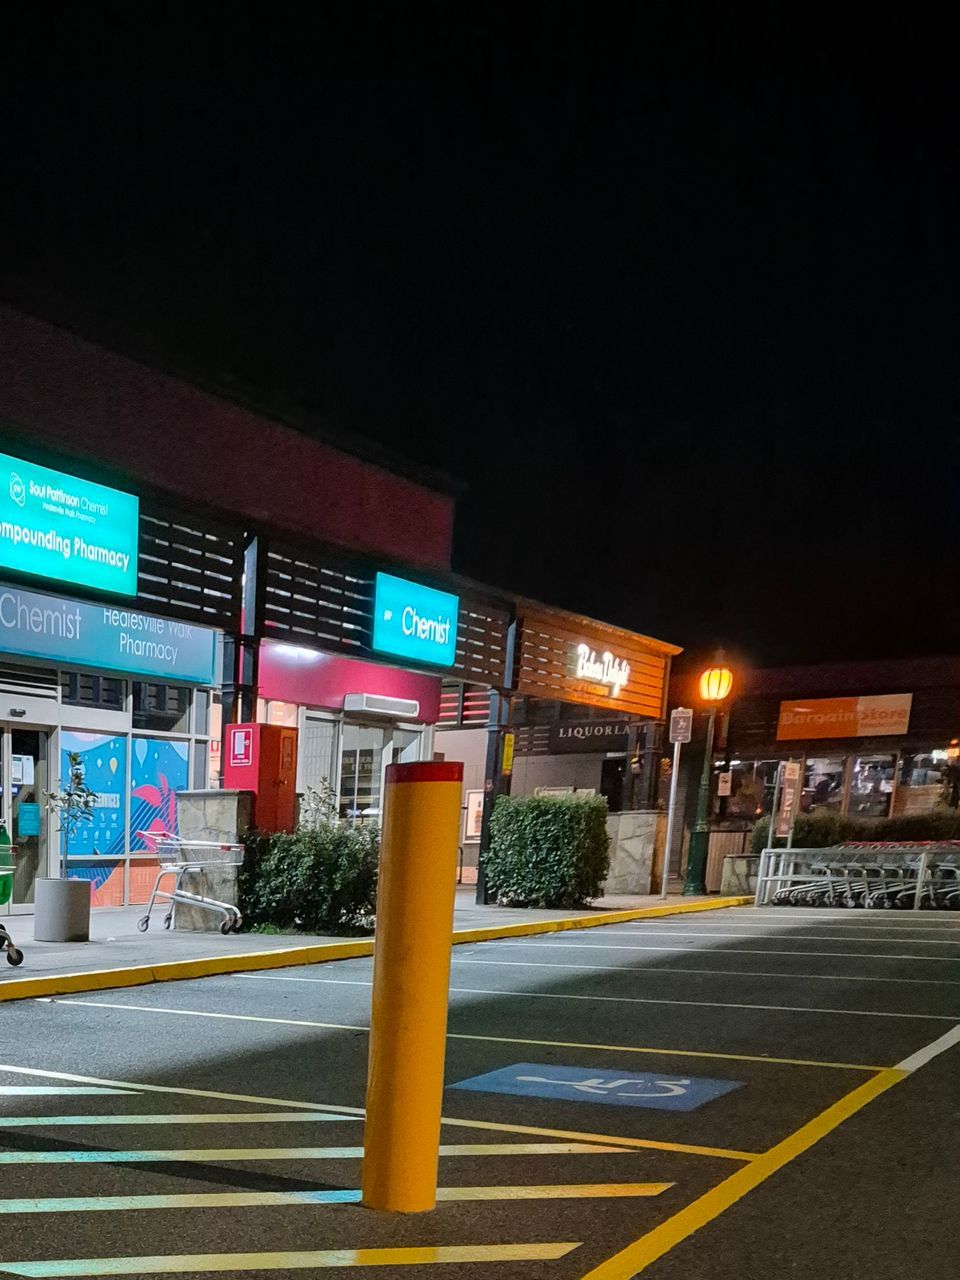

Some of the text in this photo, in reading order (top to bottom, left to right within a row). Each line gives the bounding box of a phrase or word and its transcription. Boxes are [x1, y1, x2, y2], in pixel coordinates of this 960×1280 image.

[29, 480, 109, 516] Soul Pattinson Chemist
[73, 537, 130, 572] Pharmacy
[103, 608, 164, 634] Healesville
[401, 606, 451, 645] Chemist
[119, 632, 179, 665] Pharmacy
